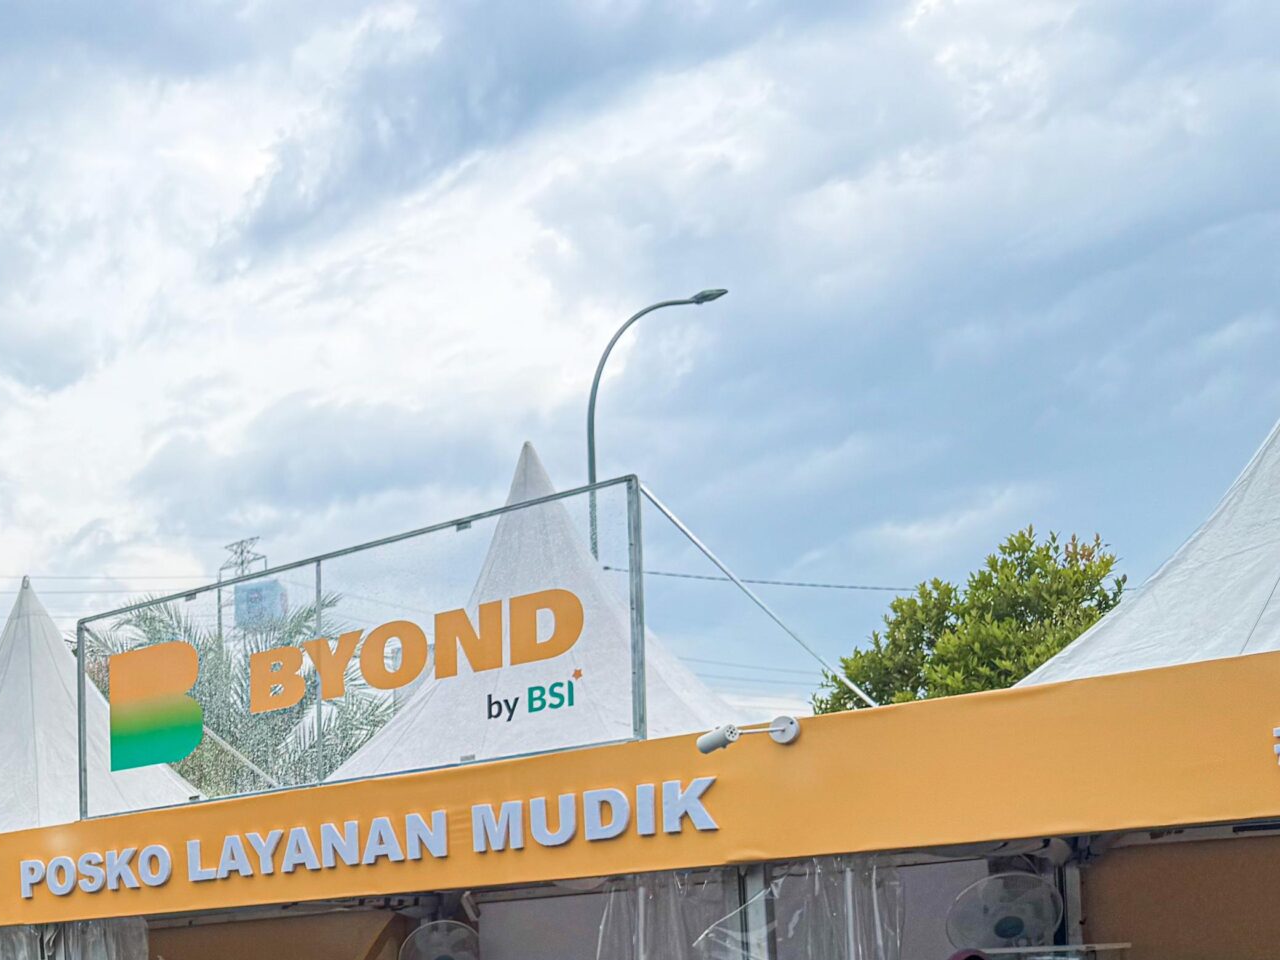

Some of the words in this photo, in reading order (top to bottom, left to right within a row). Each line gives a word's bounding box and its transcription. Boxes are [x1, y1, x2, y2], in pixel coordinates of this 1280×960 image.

[249, 588, 584, 714] BYOND
[486, 692, 519, 722] by
[527, 676, 577, 713] BSI
[21, 843, 171, 899] POSKO
[187, 810, 447, 882] LAYANAN
[472, 777, 719, 854] MUDIK
